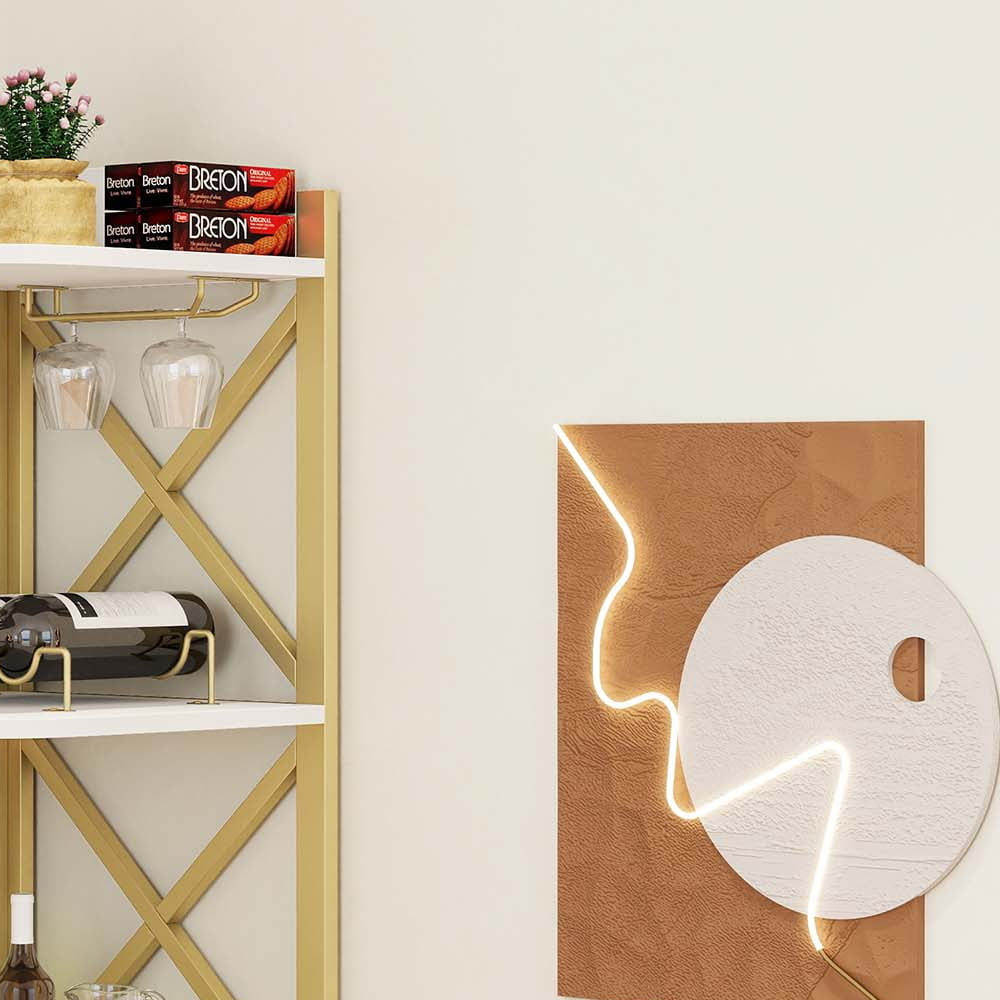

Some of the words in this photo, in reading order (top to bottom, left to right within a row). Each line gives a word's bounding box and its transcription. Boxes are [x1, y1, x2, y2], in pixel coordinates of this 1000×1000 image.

[106, 177, 135, 189] Breton
[142, 174, 171, 187] Breton
[189, 165, 247, 192] BRETON
[106, 224, 135, 237] Breton
[142, 222, 171, 235] Breton
[189, 213, 247, 239] BRETON
